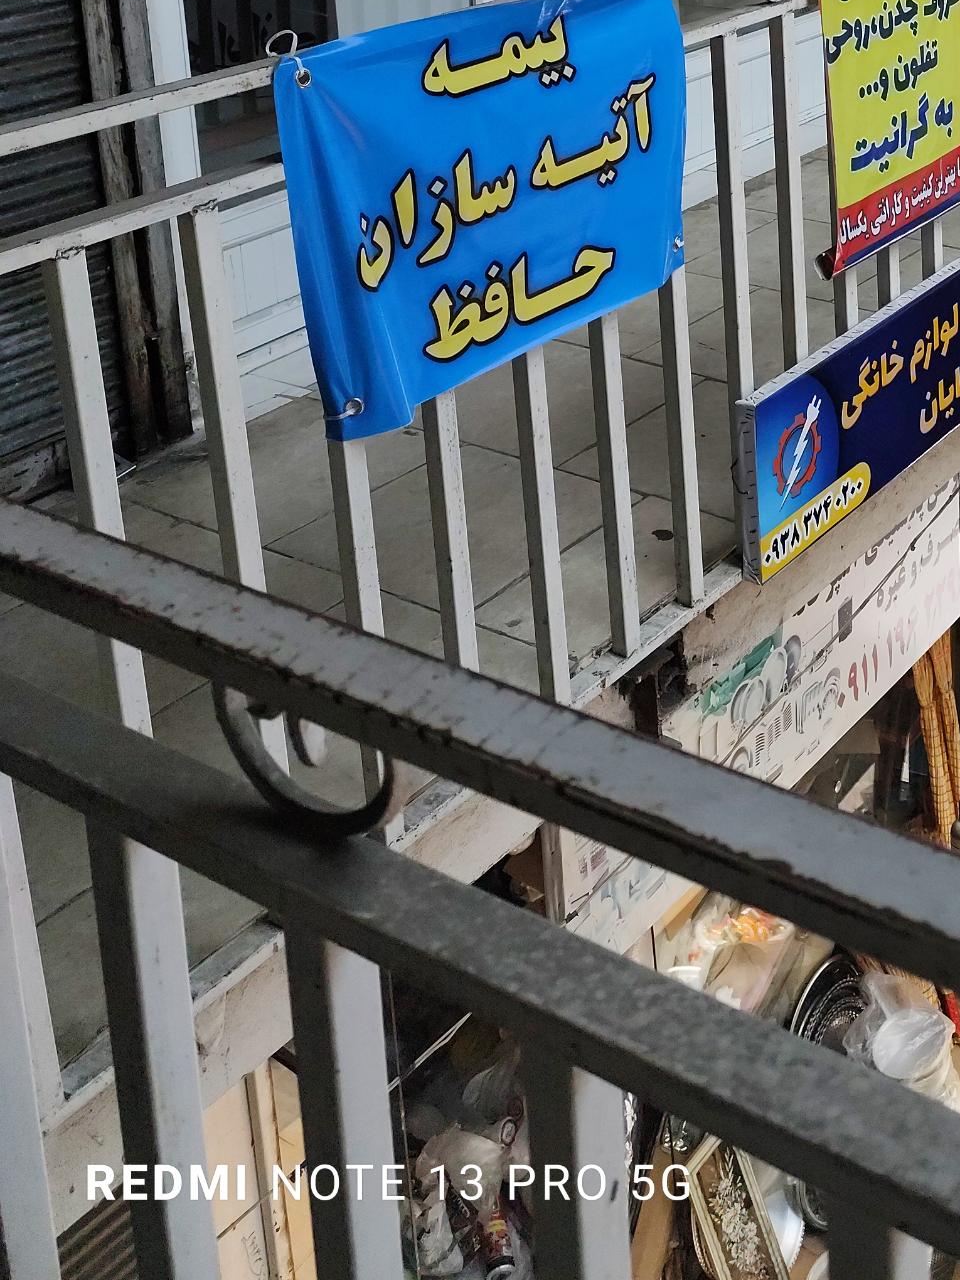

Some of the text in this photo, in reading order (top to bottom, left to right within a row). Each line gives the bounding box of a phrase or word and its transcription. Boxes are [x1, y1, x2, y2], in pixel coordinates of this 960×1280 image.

[421, 13, 577, 98] بیمه
[893, 39, 939, 93] تفلون
[850, 92, 954, 173] به گرانیت
[356, 75, 655, 291] آتیه سازان
[870, 190, 903, 236] گارانتی
[904, 195, 911, 219] و
[910, 170, 935, 208] کیفیت
[934, 164, 957, 200] بهترین
[422, 243, 617, 364] حافظ
[909, 303, 959, 382] لوازم
[841, 340, 904, 430] خانگی
